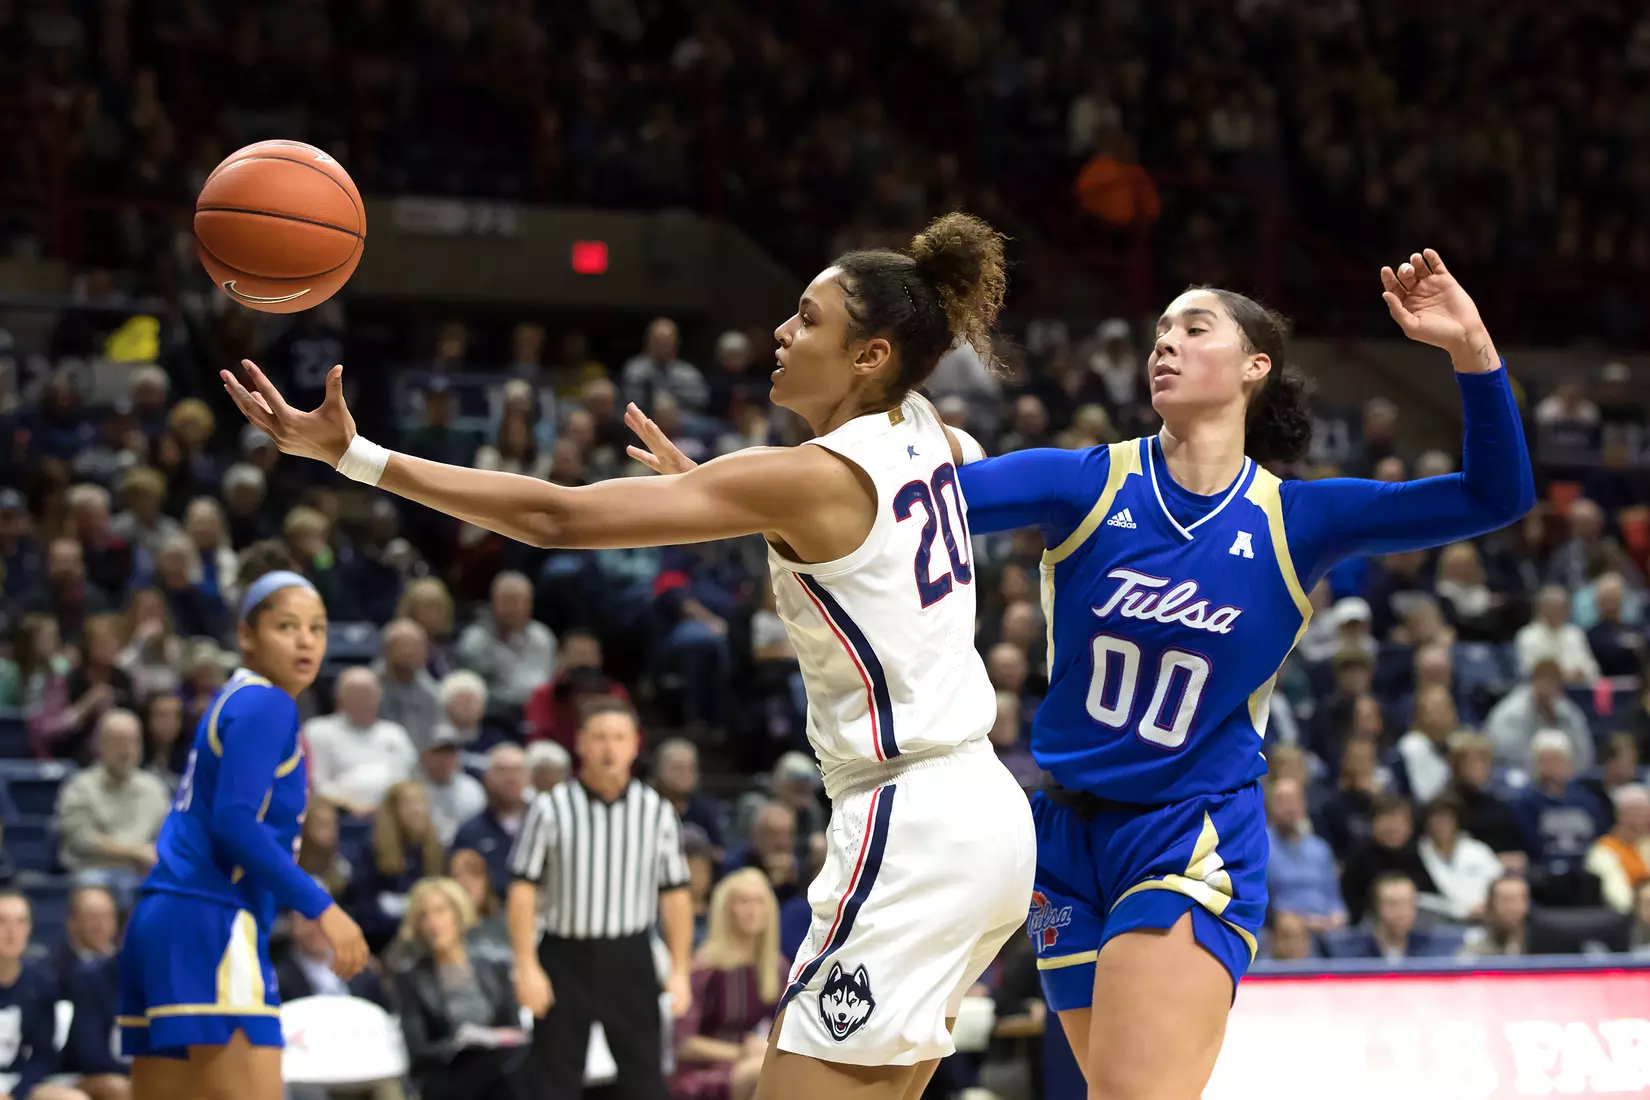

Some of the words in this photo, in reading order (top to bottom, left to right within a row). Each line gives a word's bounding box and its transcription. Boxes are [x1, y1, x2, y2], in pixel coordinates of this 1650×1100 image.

[893, 462, 972, 609] 20
[1107, 519, 1137, 529] adidas
[1229, 530, 1255, 559] A
[1092, 569, 1243, 635] Tulsa
[1086, 633, 1213, 750] 00
